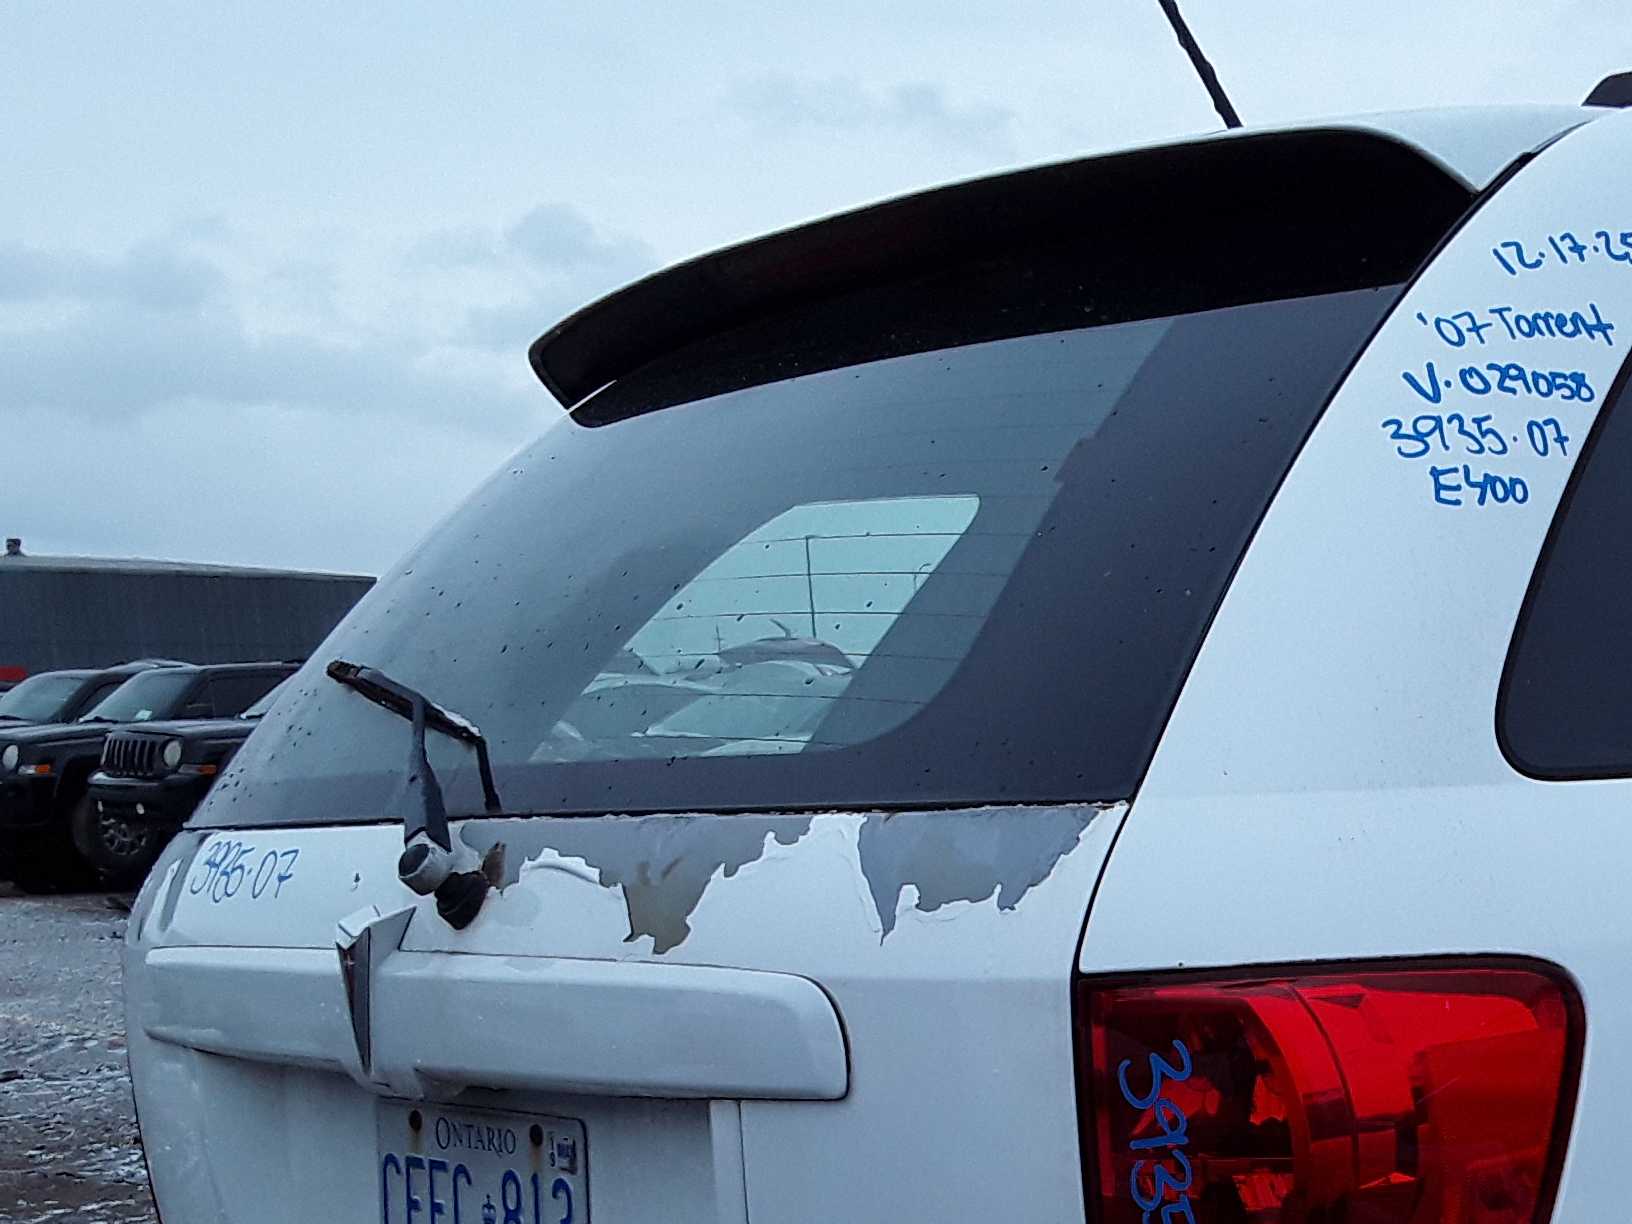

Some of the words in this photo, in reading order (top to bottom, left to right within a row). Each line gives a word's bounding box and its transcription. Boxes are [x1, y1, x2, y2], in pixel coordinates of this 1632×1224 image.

[1489, 302, 1615, 347] Torrent
[1428, 464, 1529, 506] E400
[435, 1116, 517, 1155] ONTARIO
